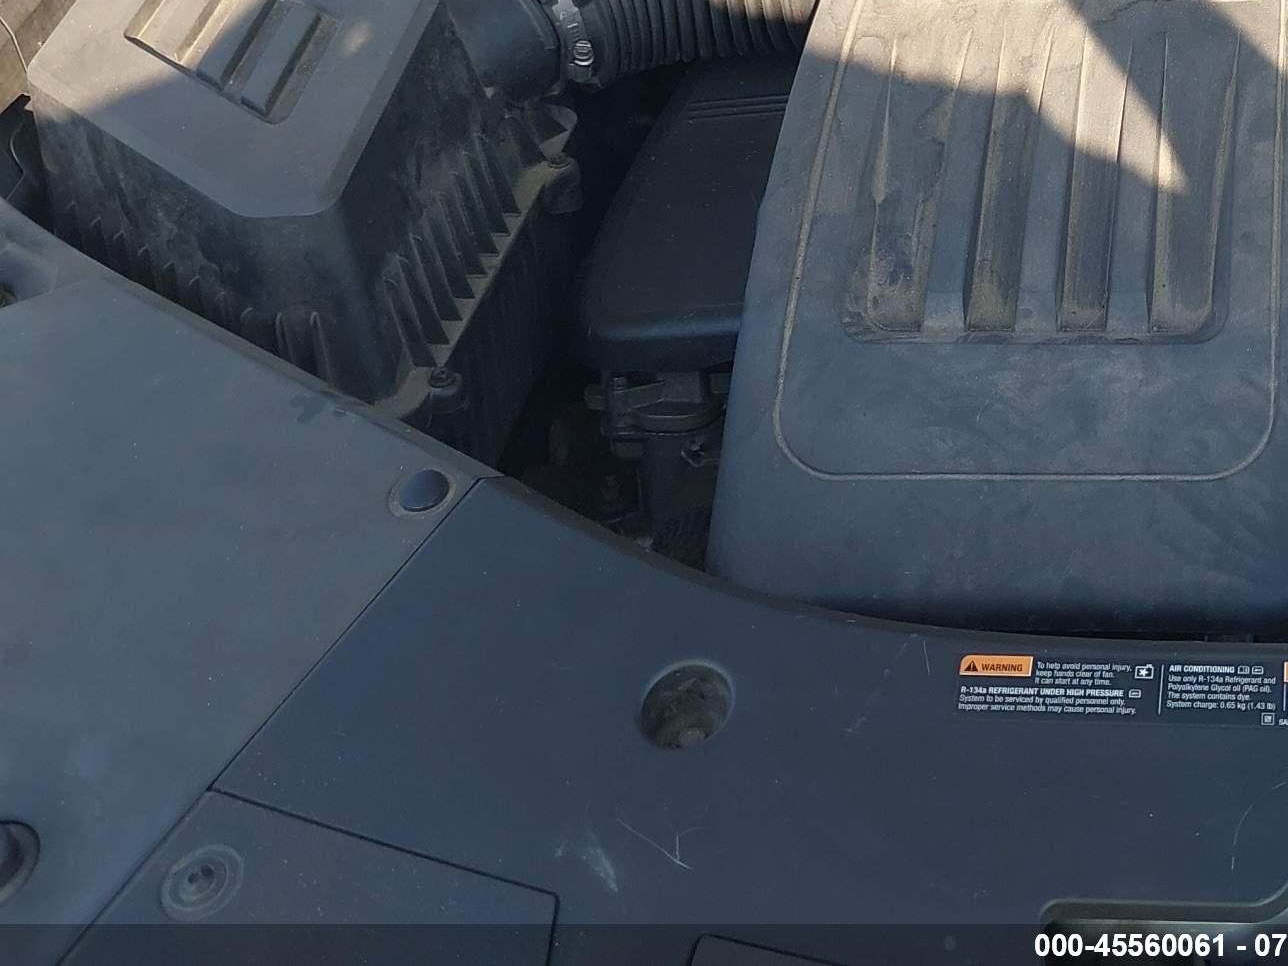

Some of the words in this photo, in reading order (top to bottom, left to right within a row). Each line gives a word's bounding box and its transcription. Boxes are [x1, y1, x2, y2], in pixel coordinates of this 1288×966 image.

[982, 663, 1023, 672] WARNING
[1046, 663, 1061, 671] help
[1082, 663, 1111, 672] personal
[1112, 664, 1132, 673] injury,
[1183, 665, 1235, 673] CONDITIONING
[1036, 670, 1052, 679] keep
[1080, 679, 1093, 687] any
[1094, 678, 1111, 686] time.
[1183, 675, 1197, 684] only
[1225, 676, 1262, 686] Refrigerant
[961, 686, 987, 694] R-134a
[988, 686, 1039, 695] REFRIGERANT
[1040, 687, 1065, 696] UNDER
[1066, 688, 1085, 696] HIGH
[1086, 688, 1124, 697] PRESSURE
[1211, 684, 1231, 693] Glycol
[1242, 685, 1258, 693] (PAG
[959, 695, 985, 704] System
[1045, 697, 1074, 706] qualified
[1075, 697, 1109, 707] personnel
[1110, 698, 1125, 707] only.
[1182, 693, 1206, 701] system
[1237, 694, 1251, 702] dye.
[958, 703, 989, 712] Improper
[1047, 705, 1062, 714] may
[1085, 706, 1115, 715] personal
[1116, 707, 1136, 716] injury.
[1167, 700, 1192, 710] System
[1193, 701, 1218, 710] charge:
[1220, 701, 1236, 709] 0.65
[1247, 702, 1265, 711] (1.43
